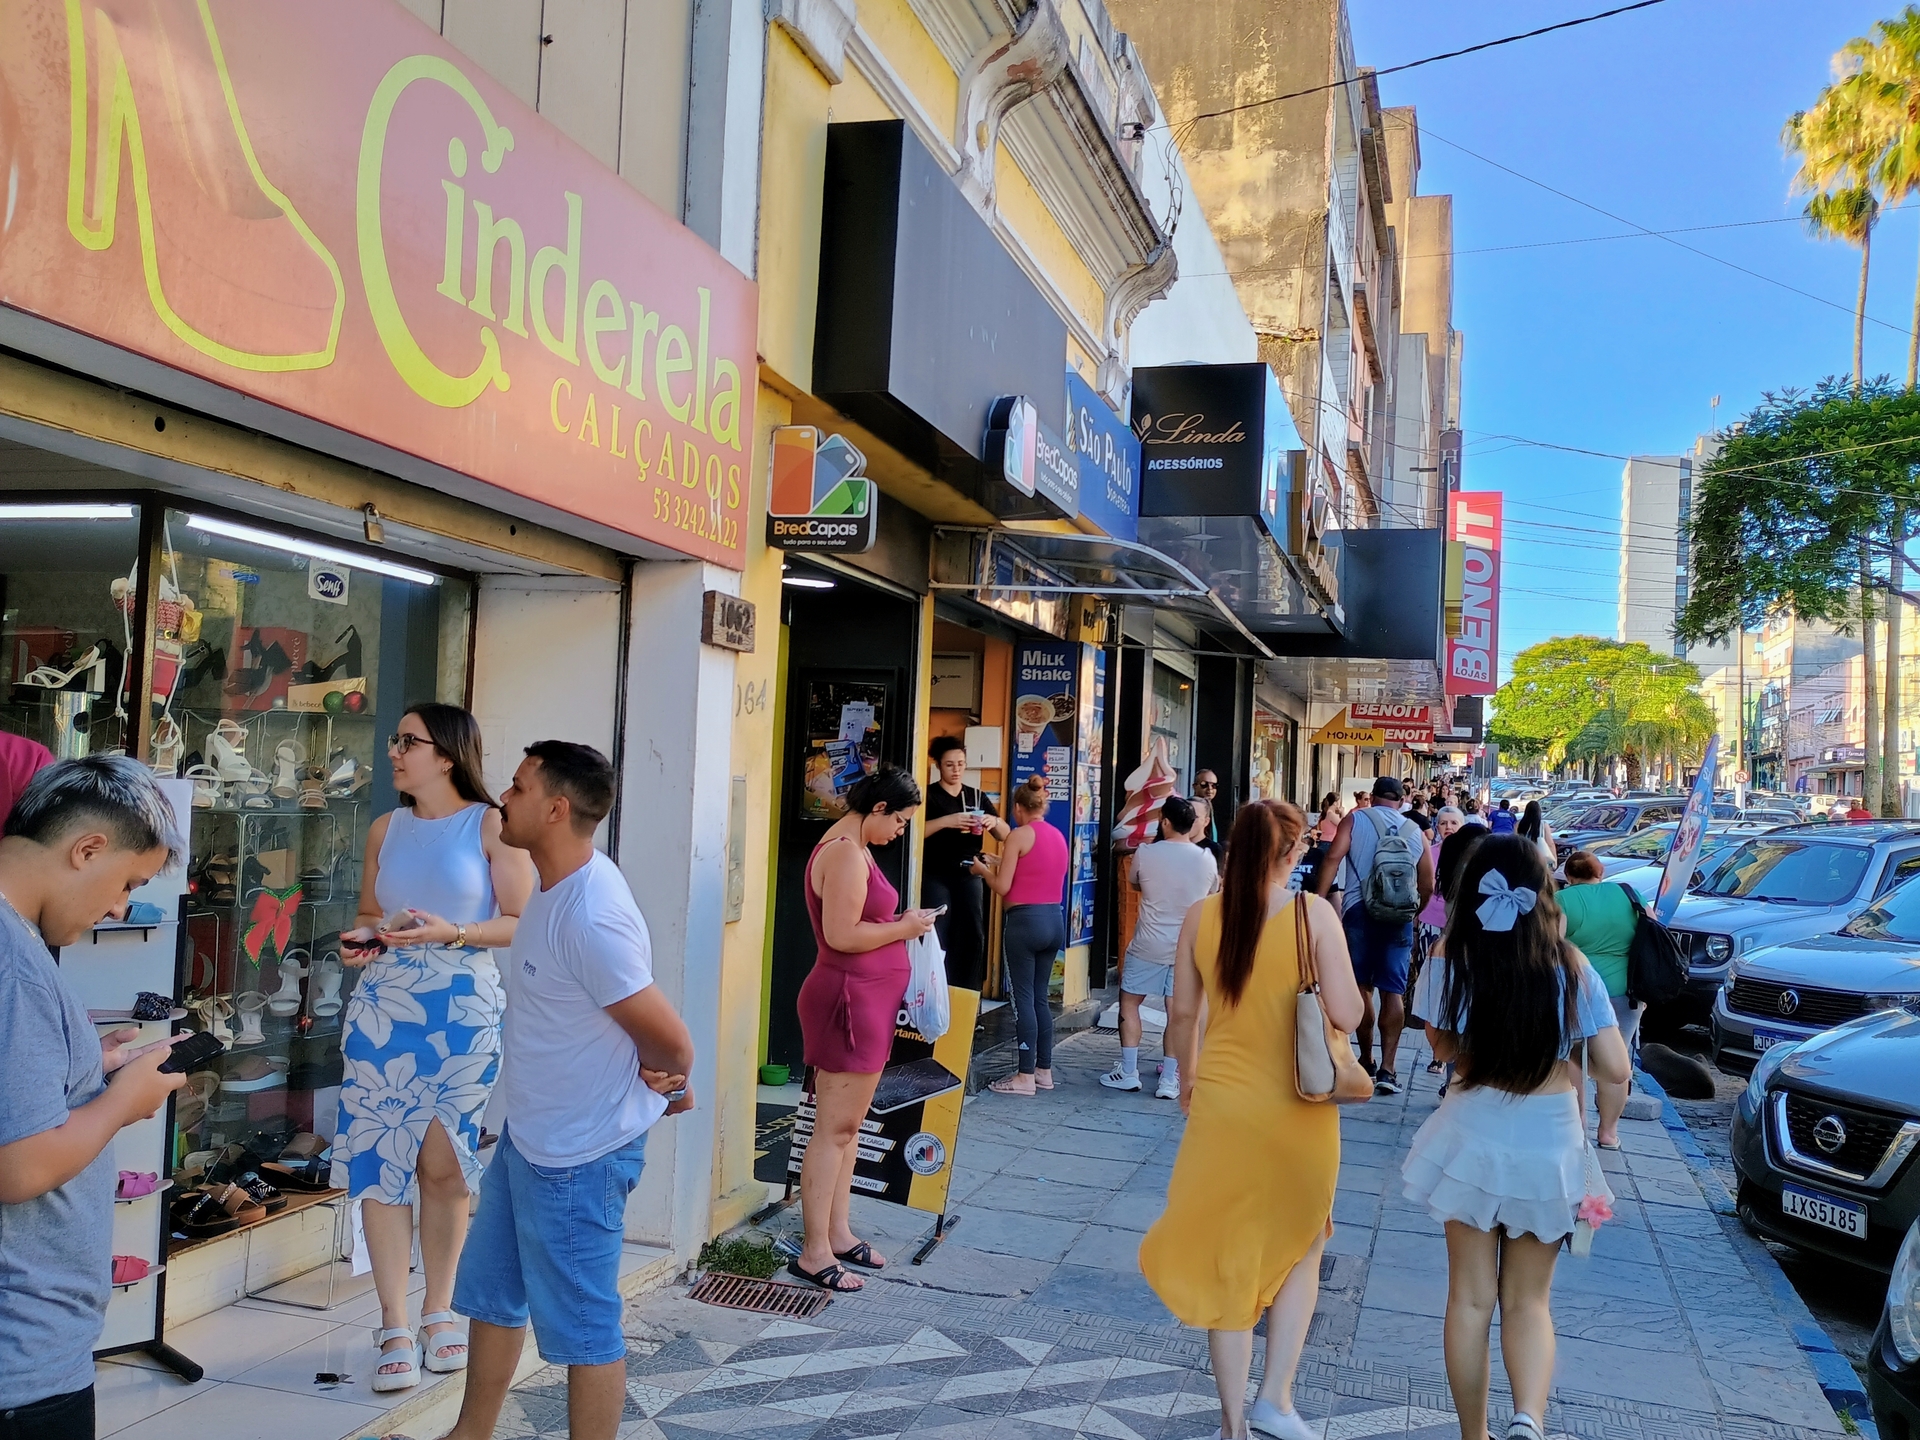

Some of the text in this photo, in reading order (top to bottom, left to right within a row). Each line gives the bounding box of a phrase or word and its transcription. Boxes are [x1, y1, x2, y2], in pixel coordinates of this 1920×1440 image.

[357, 55, 743, 451] Cinderela
[1146, 413, 1246, 445] Linda
[551, 377, 741, 509] CALÇADOS
[1036, 431, 1078, 490] BredCapas
[1147, 456, 1224, 471] ACESSÓRIOS
[653, 487, 671, 524] 53
[773, 520, 858, 539] BredCapas
[316, 574, 342, 597] Senff
[1452, 500, 1494, 683] BENOIT
[1454, 665, 1488, 682] LOJAS
[1355, 703, 1424, 719] BENOIT
[1383, 728, 1431, 742] ENOIT
[867, 1136, 885, 1147] CARGA
[854, 1177, 879, 1189] FALANTE
[1790, 1194, 1857, 1232] IXS5I85
